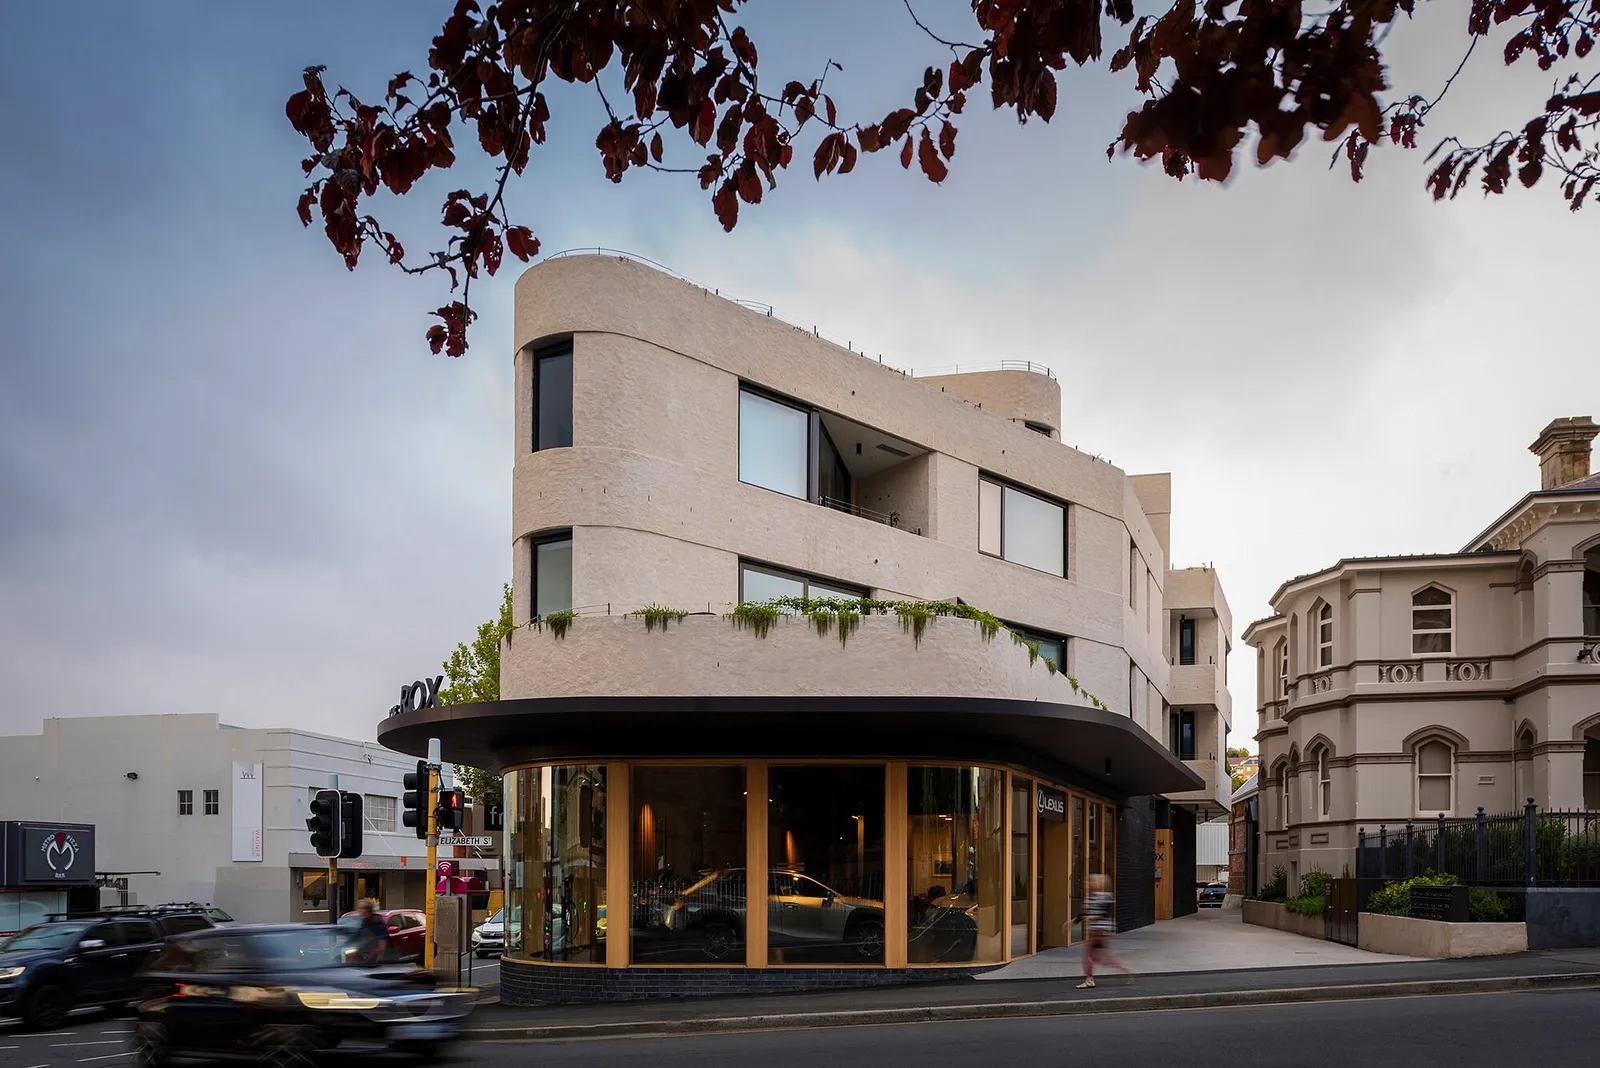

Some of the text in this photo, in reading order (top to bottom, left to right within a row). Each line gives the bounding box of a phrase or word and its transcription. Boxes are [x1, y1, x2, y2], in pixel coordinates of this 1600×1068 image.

[1044, 796, 1064, 813] LEXUS
[40, 834, 80, 853] METRO PIZZA
[440, 837, 480, 845] ELIZABETH
